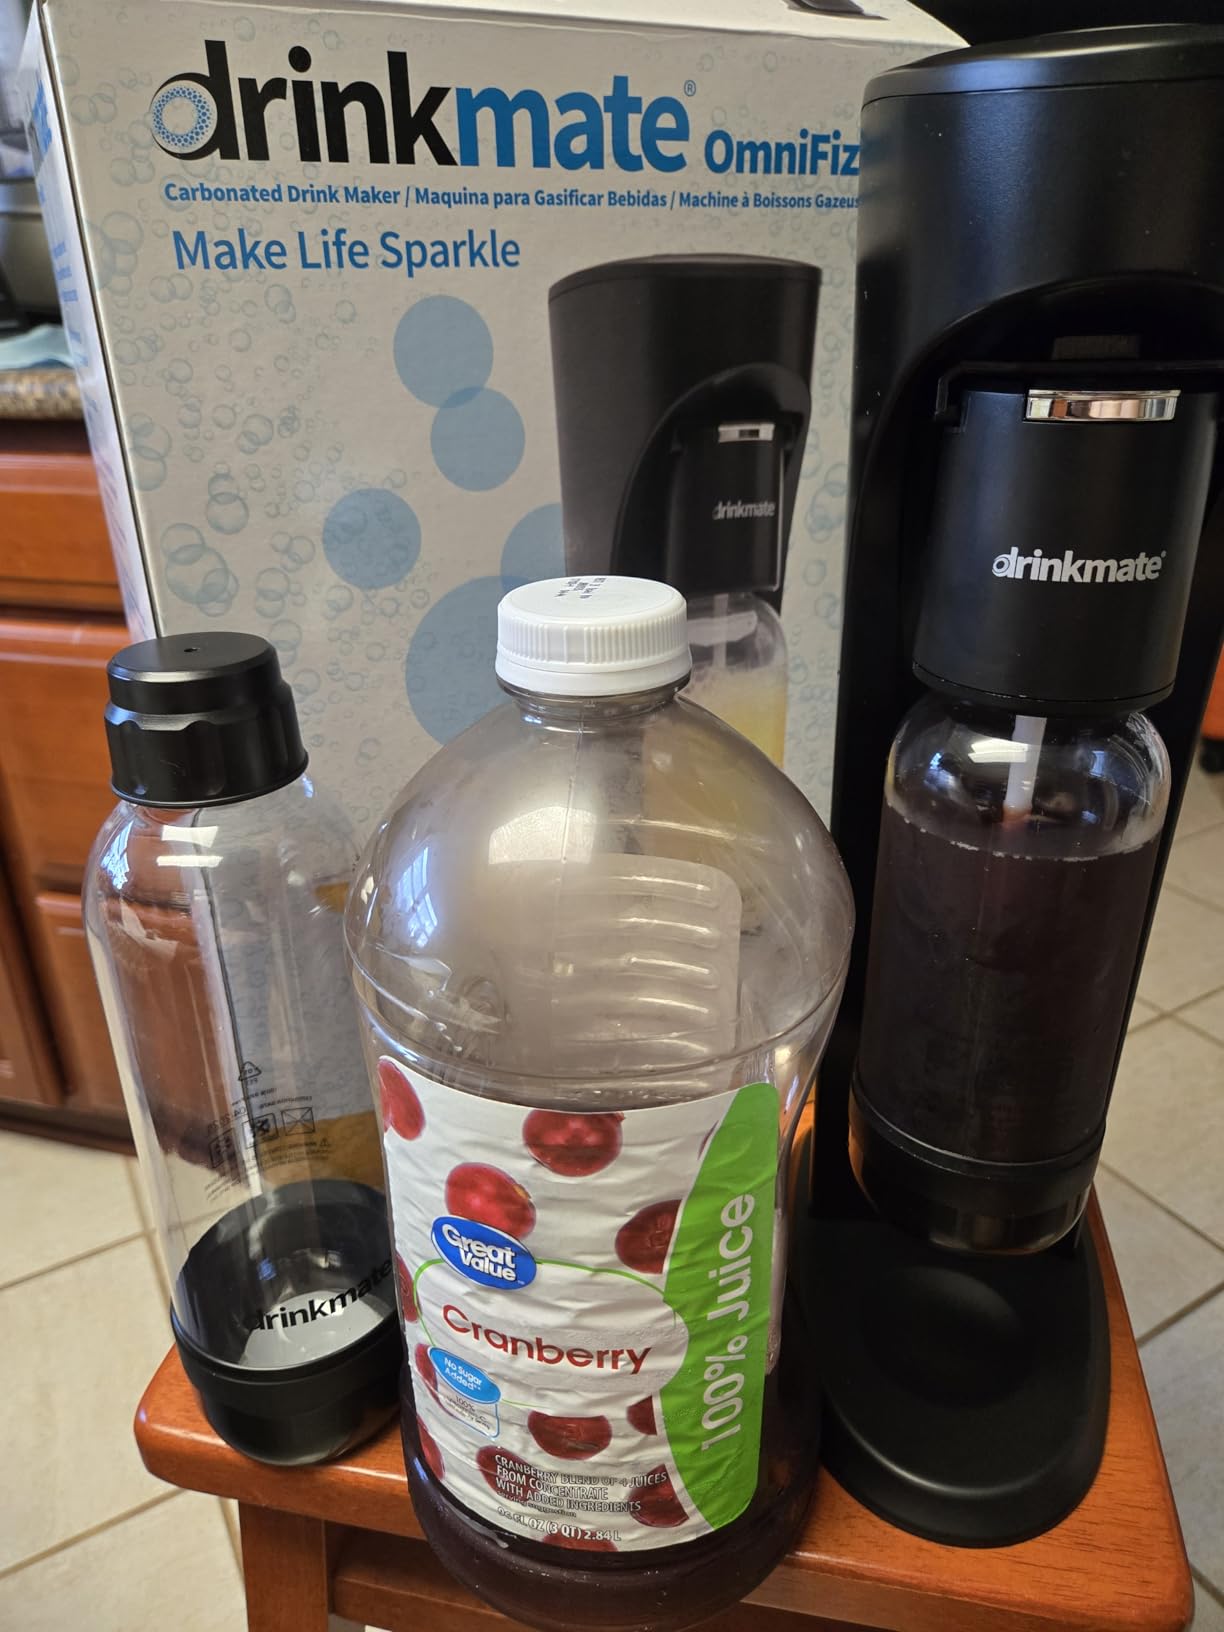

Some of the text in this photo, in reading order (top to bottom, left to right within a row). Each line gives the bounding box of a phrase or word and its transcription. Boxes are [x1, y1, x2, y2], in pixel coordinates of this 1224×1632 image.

[164, 182, 284, 201] Carbonated
[287, 185, 340, 204] Drink
[344, 186, 401, 206] Maker
[415, 187, 490, 209] Maquina
[493, 192, 530, 210] para
[534, 189, 604, 207] Gasificar
[607, 190, 667, 208] Bebidas
[679, 191, 739, 208] Machine
[753, 193, 812, 209] Boissons
[172, 228, 520, 278] Make Life Sparkle
[442, 1224, 516, 1269] Great
[459, 1248, 517, 1281] Value
[442, 1304, 651, 1375] Cranberry
[701, 1194, 756, 1451] 100% Juice
[444, 1357, 482, 1386] No Sugar
[494, 1454, 559, 1484] CRANBERRY
[560, 1474, 599, 1486] BLEND
[629, 1471, 668, 1489] JUICES
[496, 1464, 609, 1501] FROM CONCENTRATE
[495, 1476, 642, 1514] WITH ADDED INGREDIENTS
[528, 1517, 546, 1533] OZ
[545, 1520, 559, 1535] (3
[561, 1524, 582, 1540] QT)
[583, 1529, 612, 1541] 2.84
[613, 1529, 622, 1542] L
